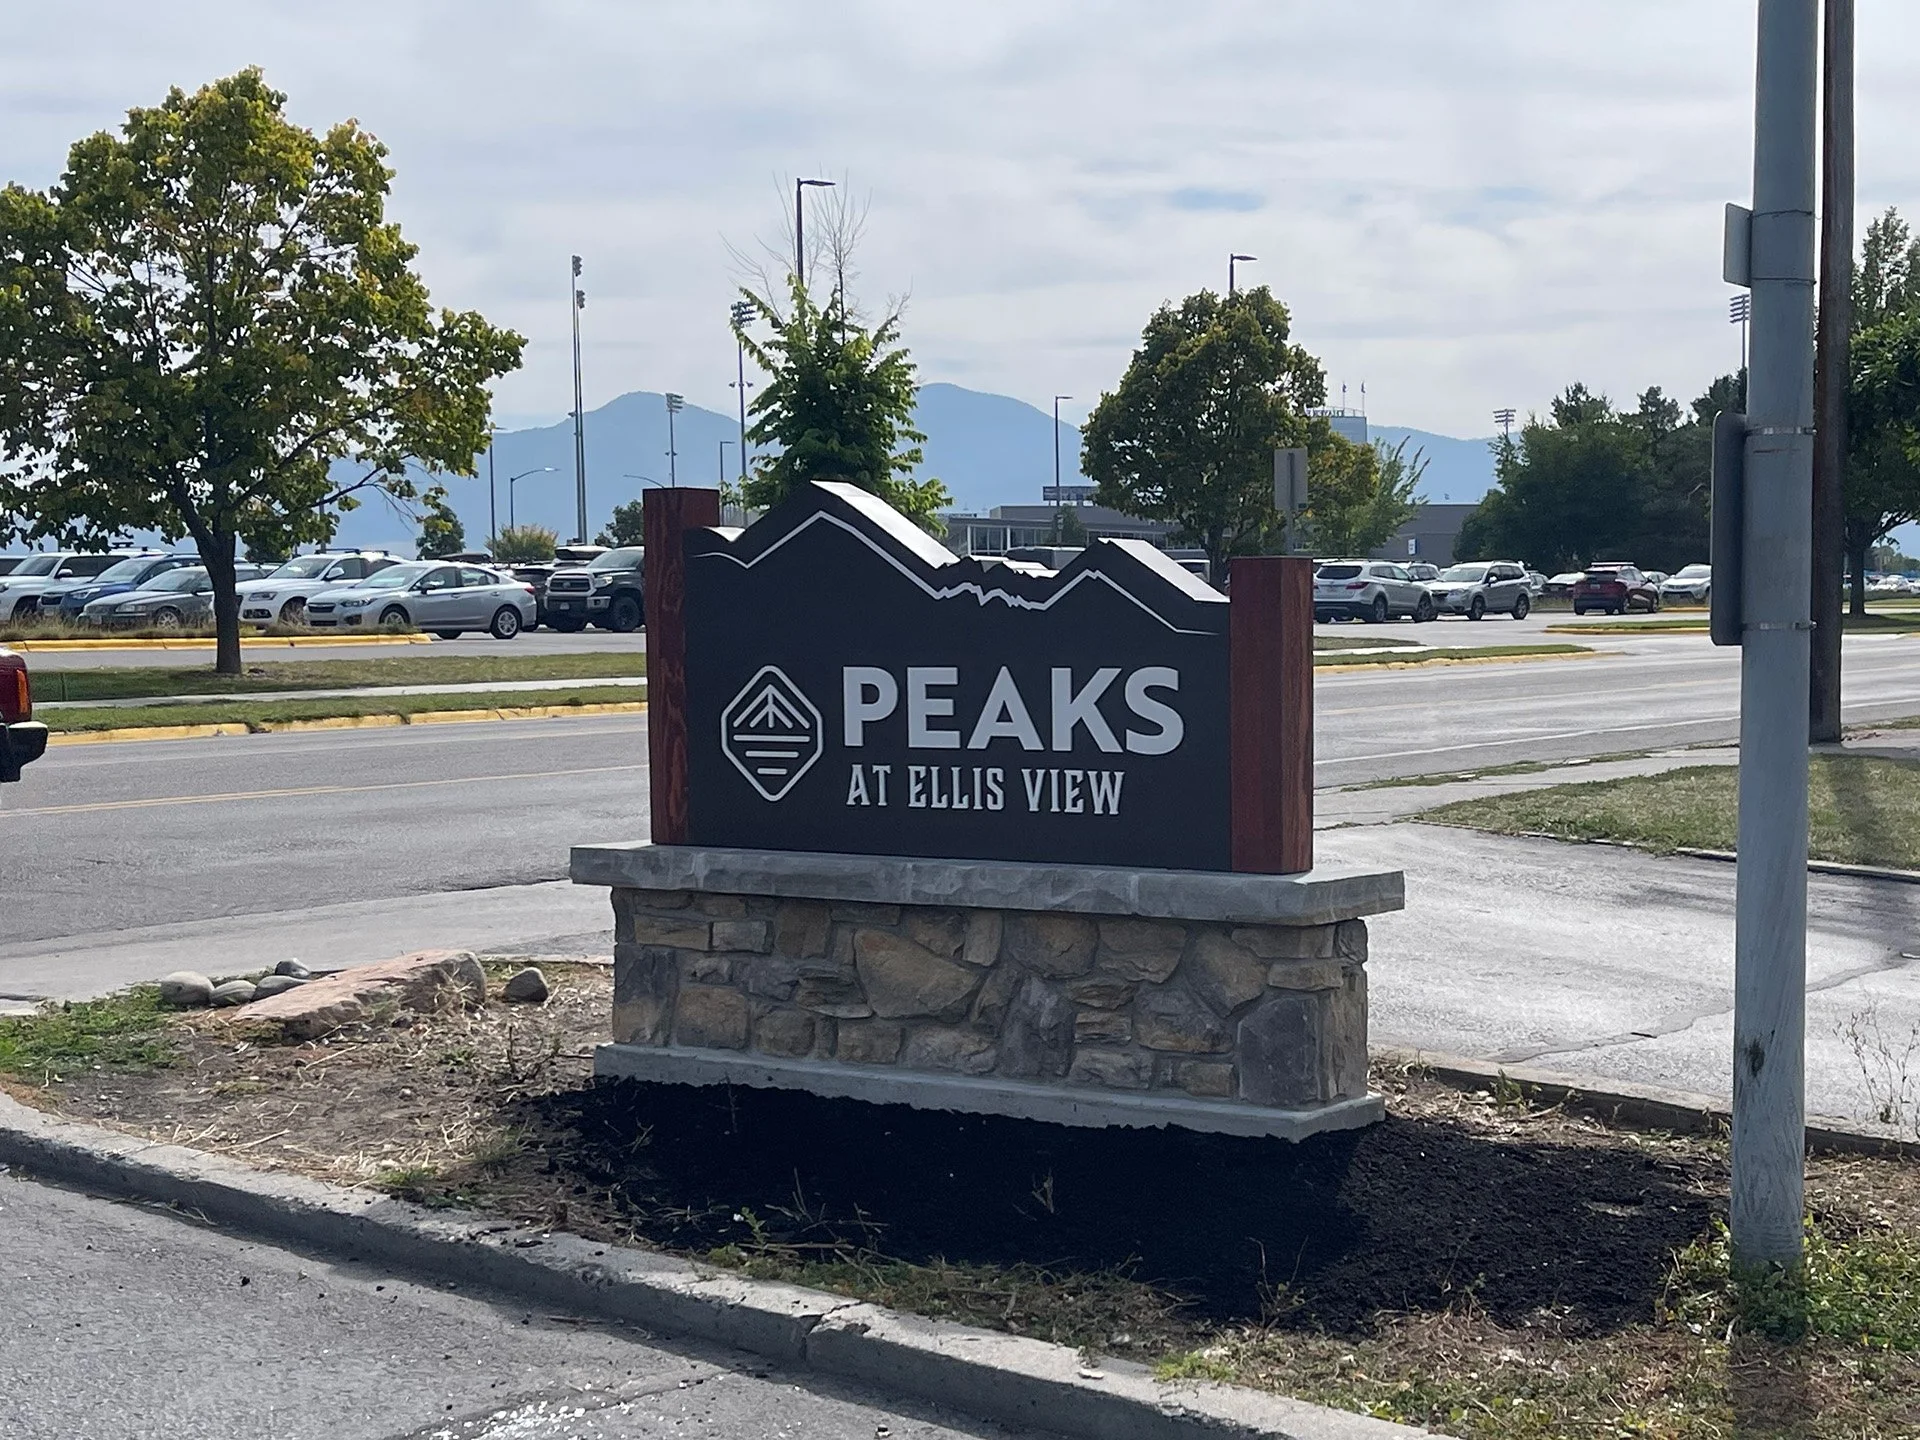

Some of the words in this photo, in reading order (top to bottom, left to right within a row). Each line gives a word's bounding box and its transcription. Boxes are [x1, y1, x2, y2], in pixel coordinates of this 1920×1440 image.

[843, 666, 1184, 755] PEAKS
[847, 765, 891, 808] AT
[908, 766, 1004, 810] ELLIS
[1021, 769, 1125, 815] VIEW
